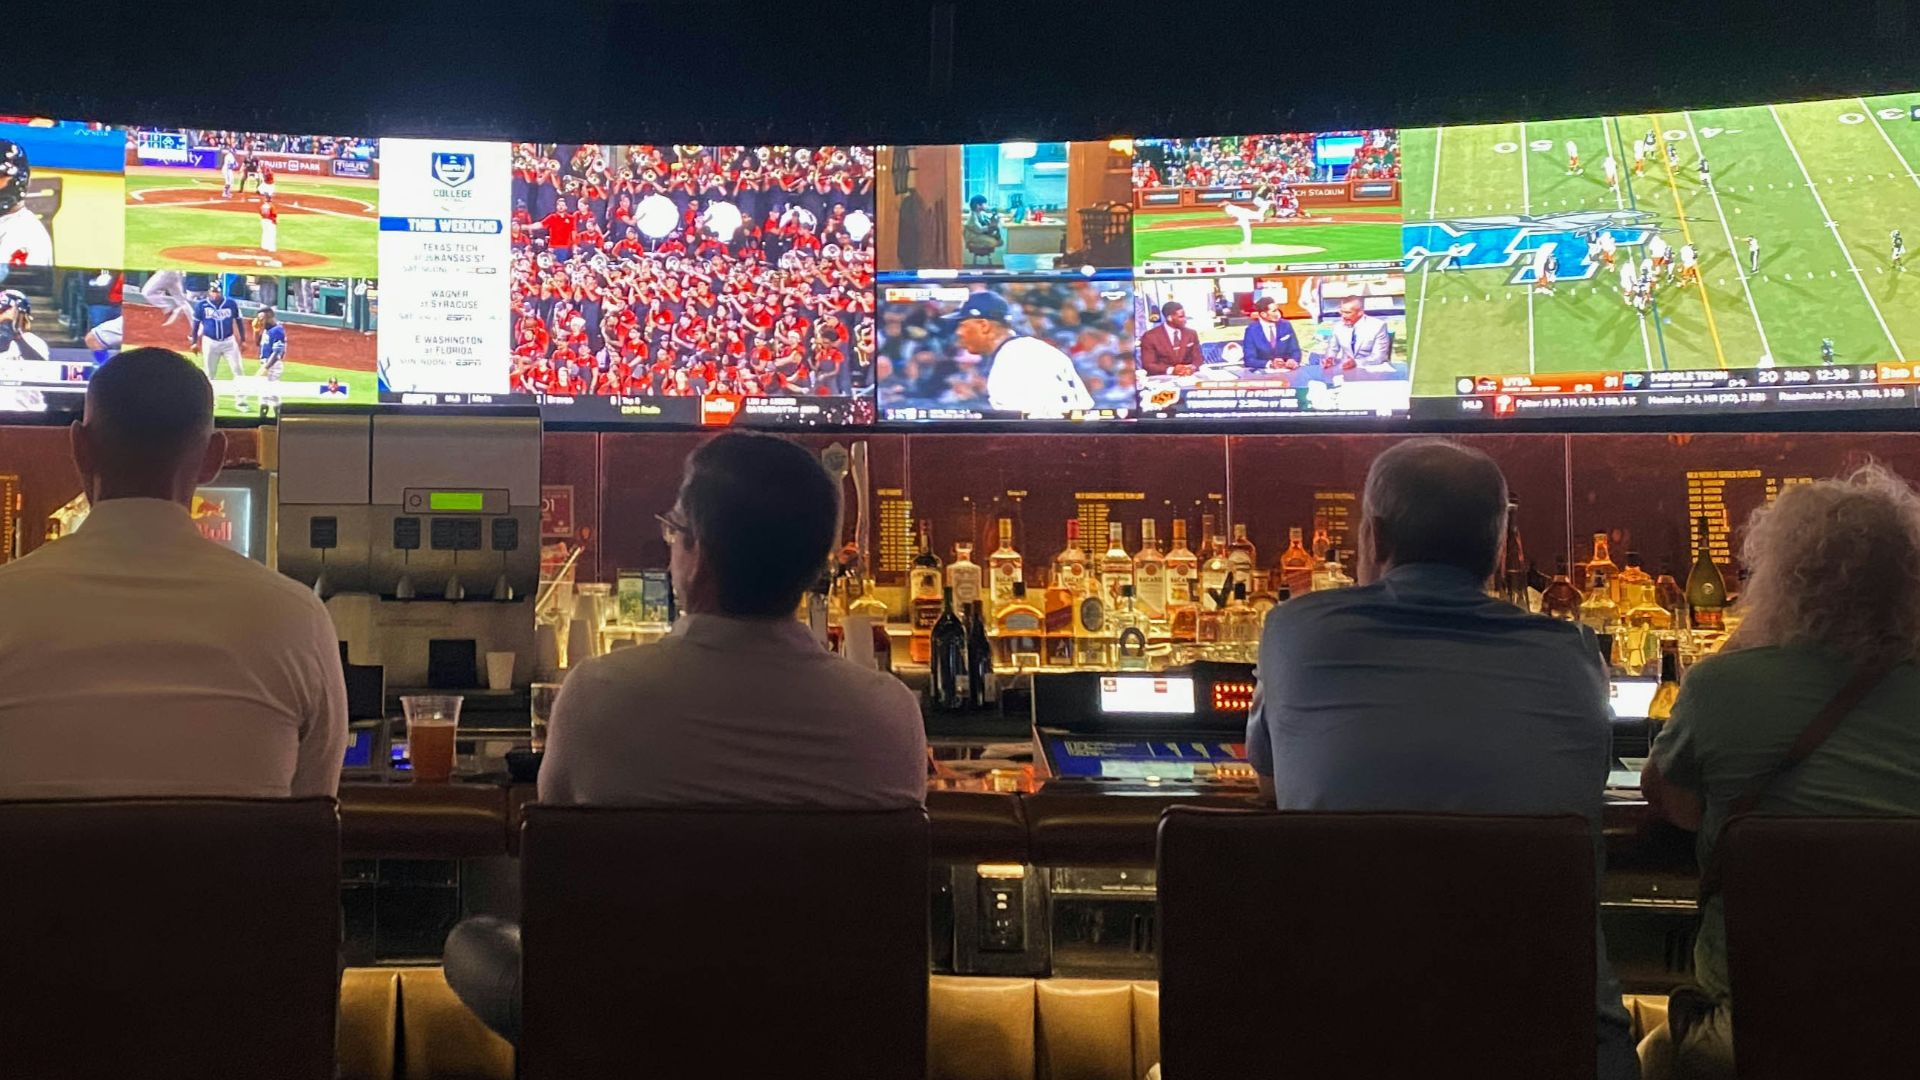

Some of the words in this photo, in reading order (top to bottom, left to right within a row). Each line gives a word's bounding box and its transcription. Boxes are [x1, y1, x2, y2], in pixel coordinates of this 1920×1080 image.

[300, 163, 320, 171] PARK
[433, 189, 472, 198] COLLEGE
[1309, 188, 1345, 196] STADIUM
[439, 218, 498, 232] WEEKEND
[423, 243, 452, 252] TEXAS
[456, 243, 478, 252] TECH
[431, 290, 469, 298] WAGNER
[431, 300, 479, 309] SYRACUSE
[415, 335, 421, 343] E
[424, 336, 483, 344] WASHINGTON
[435, 346, 473, 355] FLORIDA
[1502, 376, 1532, 387] UTSA
[1650, 372, 1695, 382] MIDDLE
[1758, 371, 1778, 383] 20
